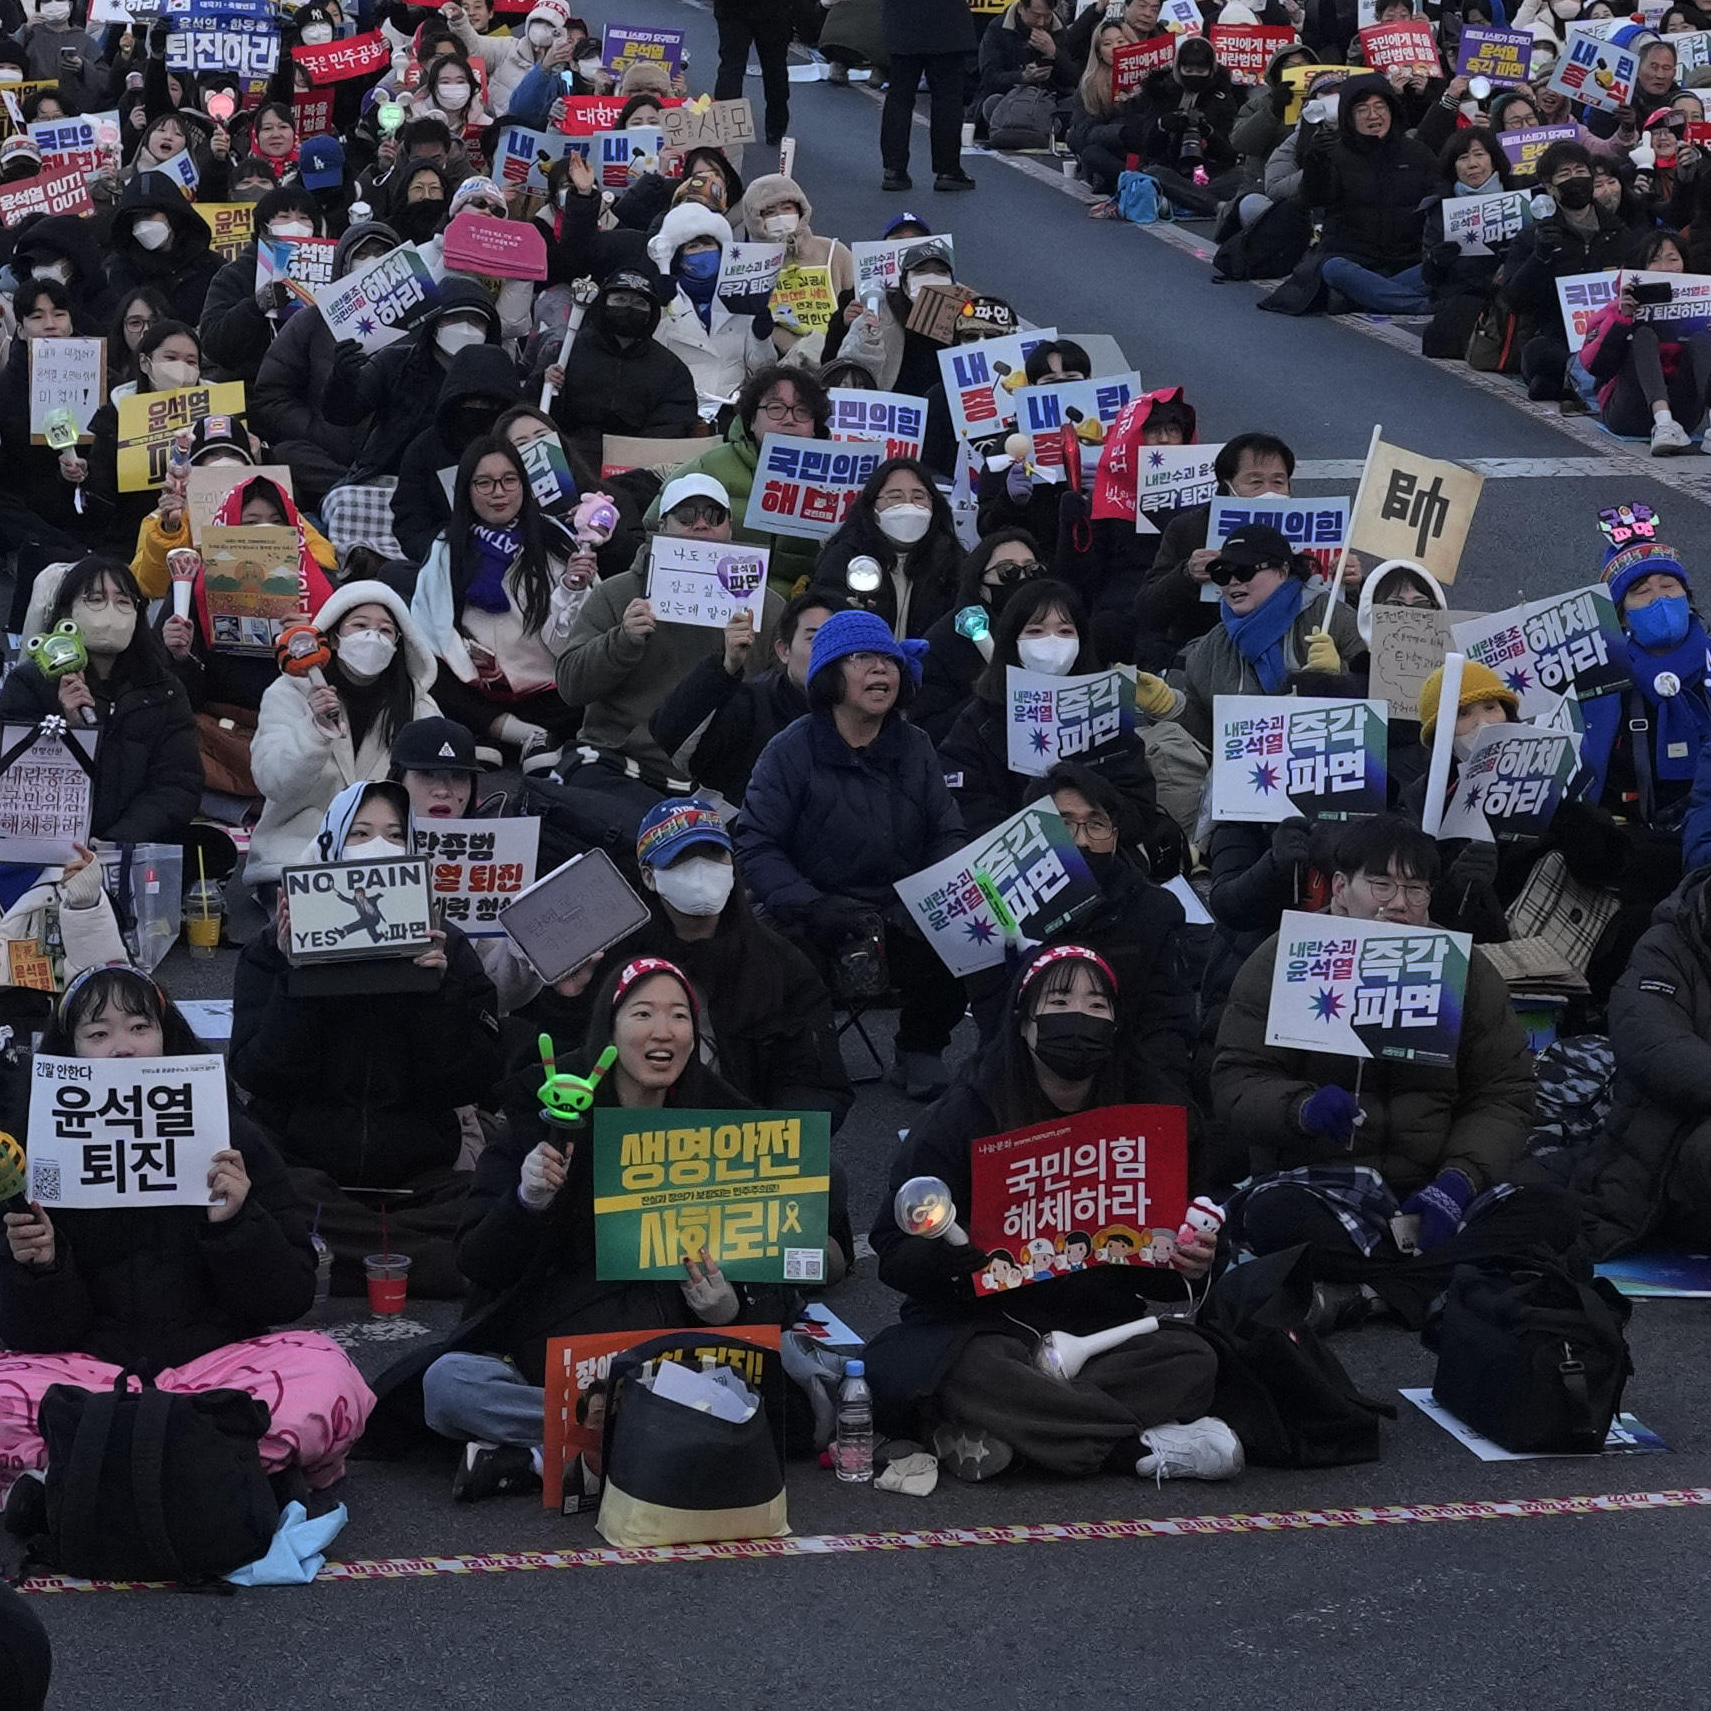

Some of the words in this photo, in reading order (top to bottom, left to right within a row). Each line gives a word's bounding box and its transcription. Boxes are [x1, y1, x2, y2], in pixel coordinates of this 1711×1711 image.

[165, 33, 280, 70] 퇴진하라
[47, 173, 82, 194] OUT!
[766, 451, 882, 481] 국민의힘
[727, 573, 761, 591] 파면
[1523, 589, 1602, 648] 해체
[1539, 630, 1610, 691] 하라
[1013, 689, 1054, 707] 내란수괴
[1013, 704, 1054, 725] 윤석열
[1055, 670, 1123, 722] 즉각
[1055, 711, 1121, 760] 파면
[1222, 734, 1285, 762] 윤석열
[1223, 715, 1286, 738] 내란수괴
[1290, 703, 1369, 758] 즉각
[1289, 755, 1367, 797] 파면
[287, 870, 334, 895] NO
[346, 865, 422, 891] PAIN
[293, 929, 338, 950] YES
[1287, 937, 1357, 963] 내란수괴
[1359, 934, 1450, 988] 즉각
[1353, 982, 1443, 1031] 파면
[57, 1063, 94, 1082] 안한다
[51, 1081, 196, 1140] 윤석열
[78, 1138, 180, 1194] 퇴진
[619, 1118, 802, 1190] 생명안전
[1004, 1135, 1147, 1197] 국민의힘
[638, 1198, 780, 1269] 사회로!
[1001, 1181, 1151, 1241] 해체하라
